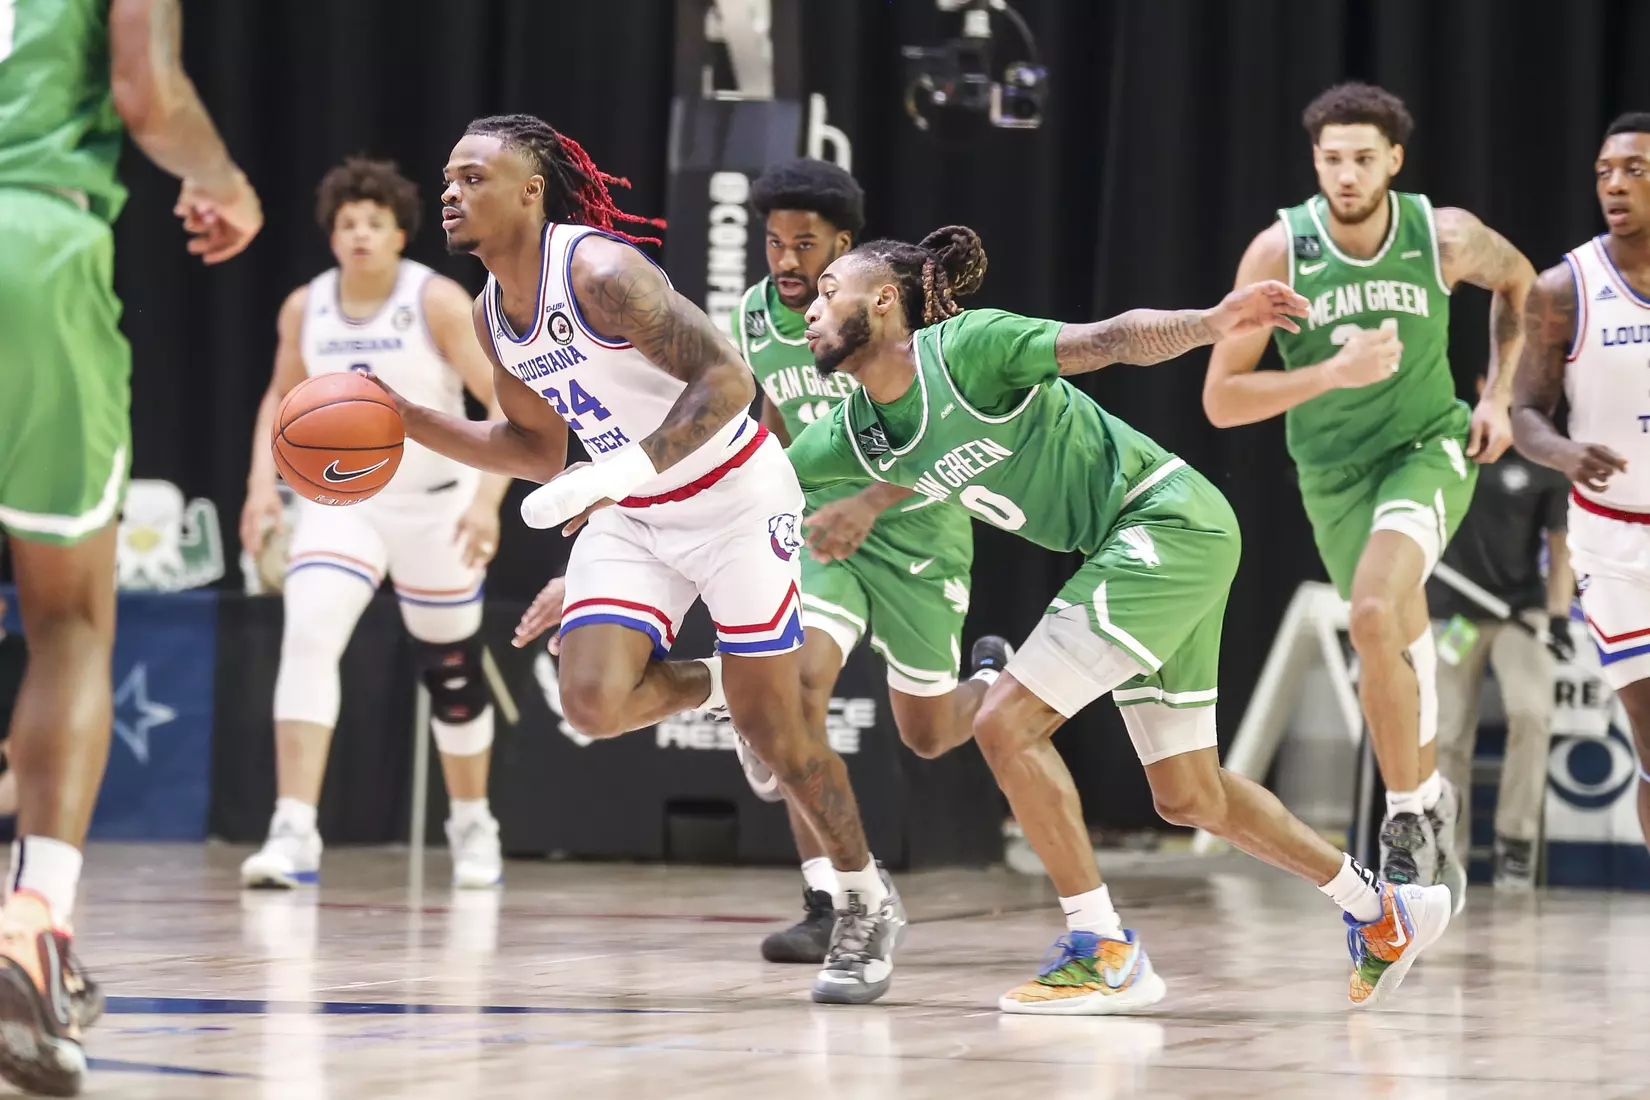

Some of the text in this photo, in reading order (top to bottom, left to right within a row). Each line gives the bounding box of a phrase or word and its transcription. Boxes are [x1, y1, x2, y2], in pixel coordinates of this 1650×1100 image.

[1308, 279, 1430, 331] MEAN GREEN
[1602, 325, 1650, 347] LOU
[511, 345, 588, 383] LOUISIANA
[541, 378, 613, 431] 24
[582, 426, 631, 454] TECH
[934, 437, 1014, 489] GREEN
[959, 485, 1028, 531] 0
